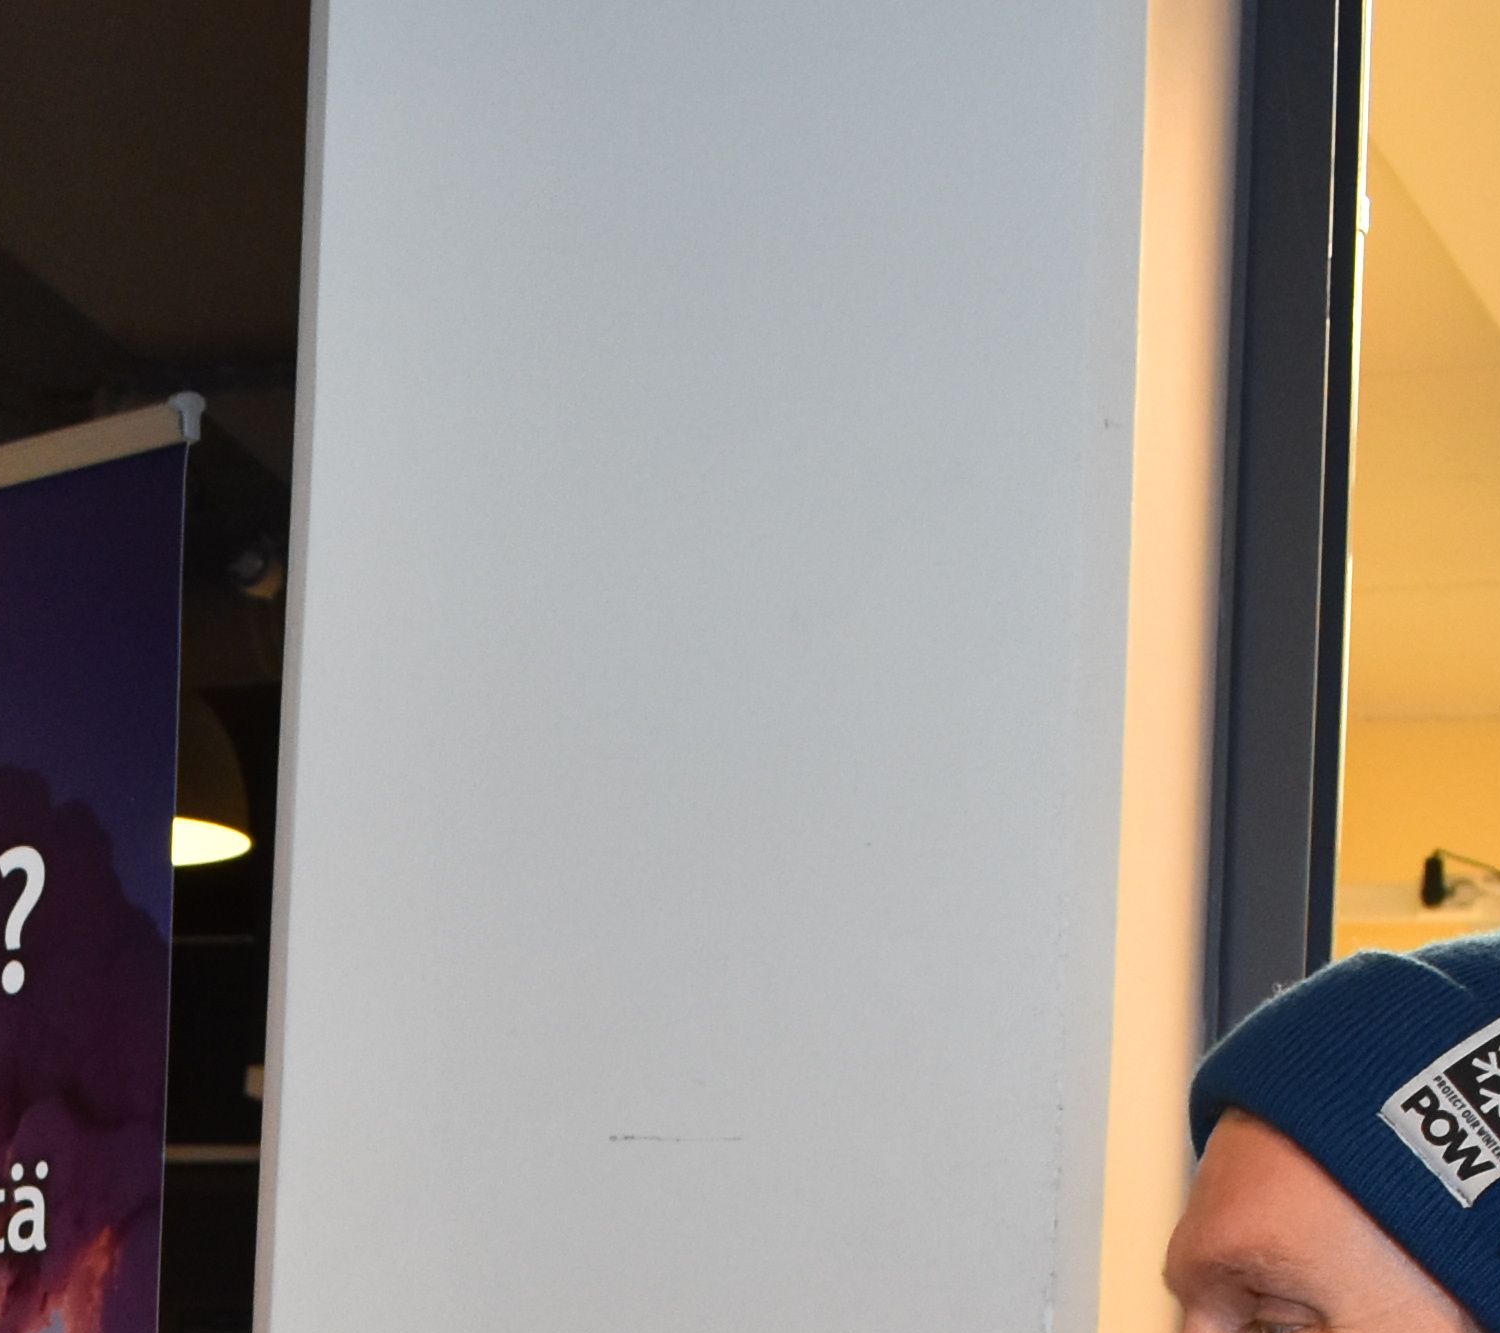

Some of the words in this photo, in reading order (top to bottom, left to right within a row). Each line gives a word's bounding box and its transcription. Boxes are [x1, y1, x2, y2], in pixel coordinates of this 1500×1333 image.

[1400, 1085, 1497, 1182] POW
[1433, 1074, 1466, 1115] PROTECT
[1462, 1109, 1480, 1130] OUR
